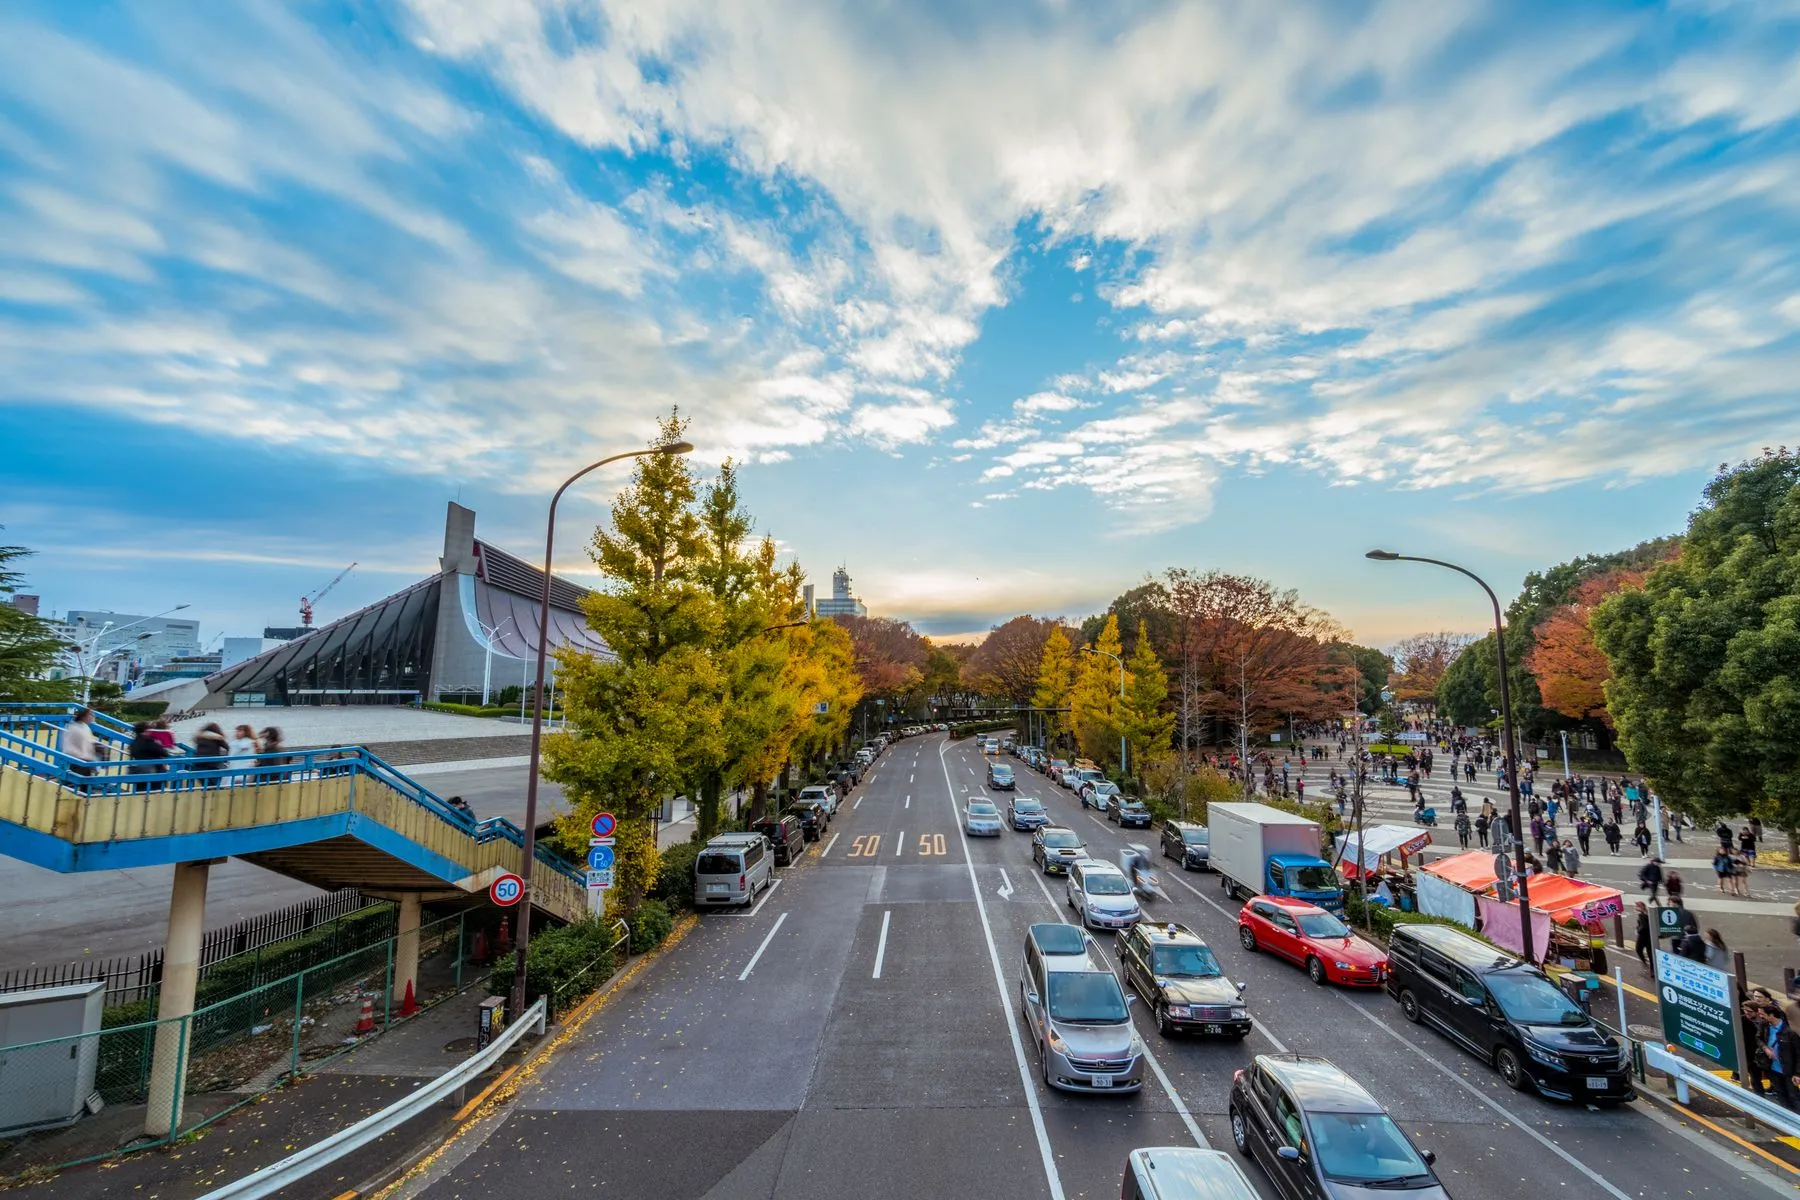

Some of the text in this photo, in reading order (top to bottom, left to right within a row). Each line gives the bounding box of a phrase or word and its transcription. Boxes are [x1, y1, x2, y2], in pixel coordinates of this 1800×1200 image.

[847, 835, 880, 856] 50
[918, 834, 947, 855] 50
[594, 852, 604, 867] P
[498, 882, 517, 897] 50
